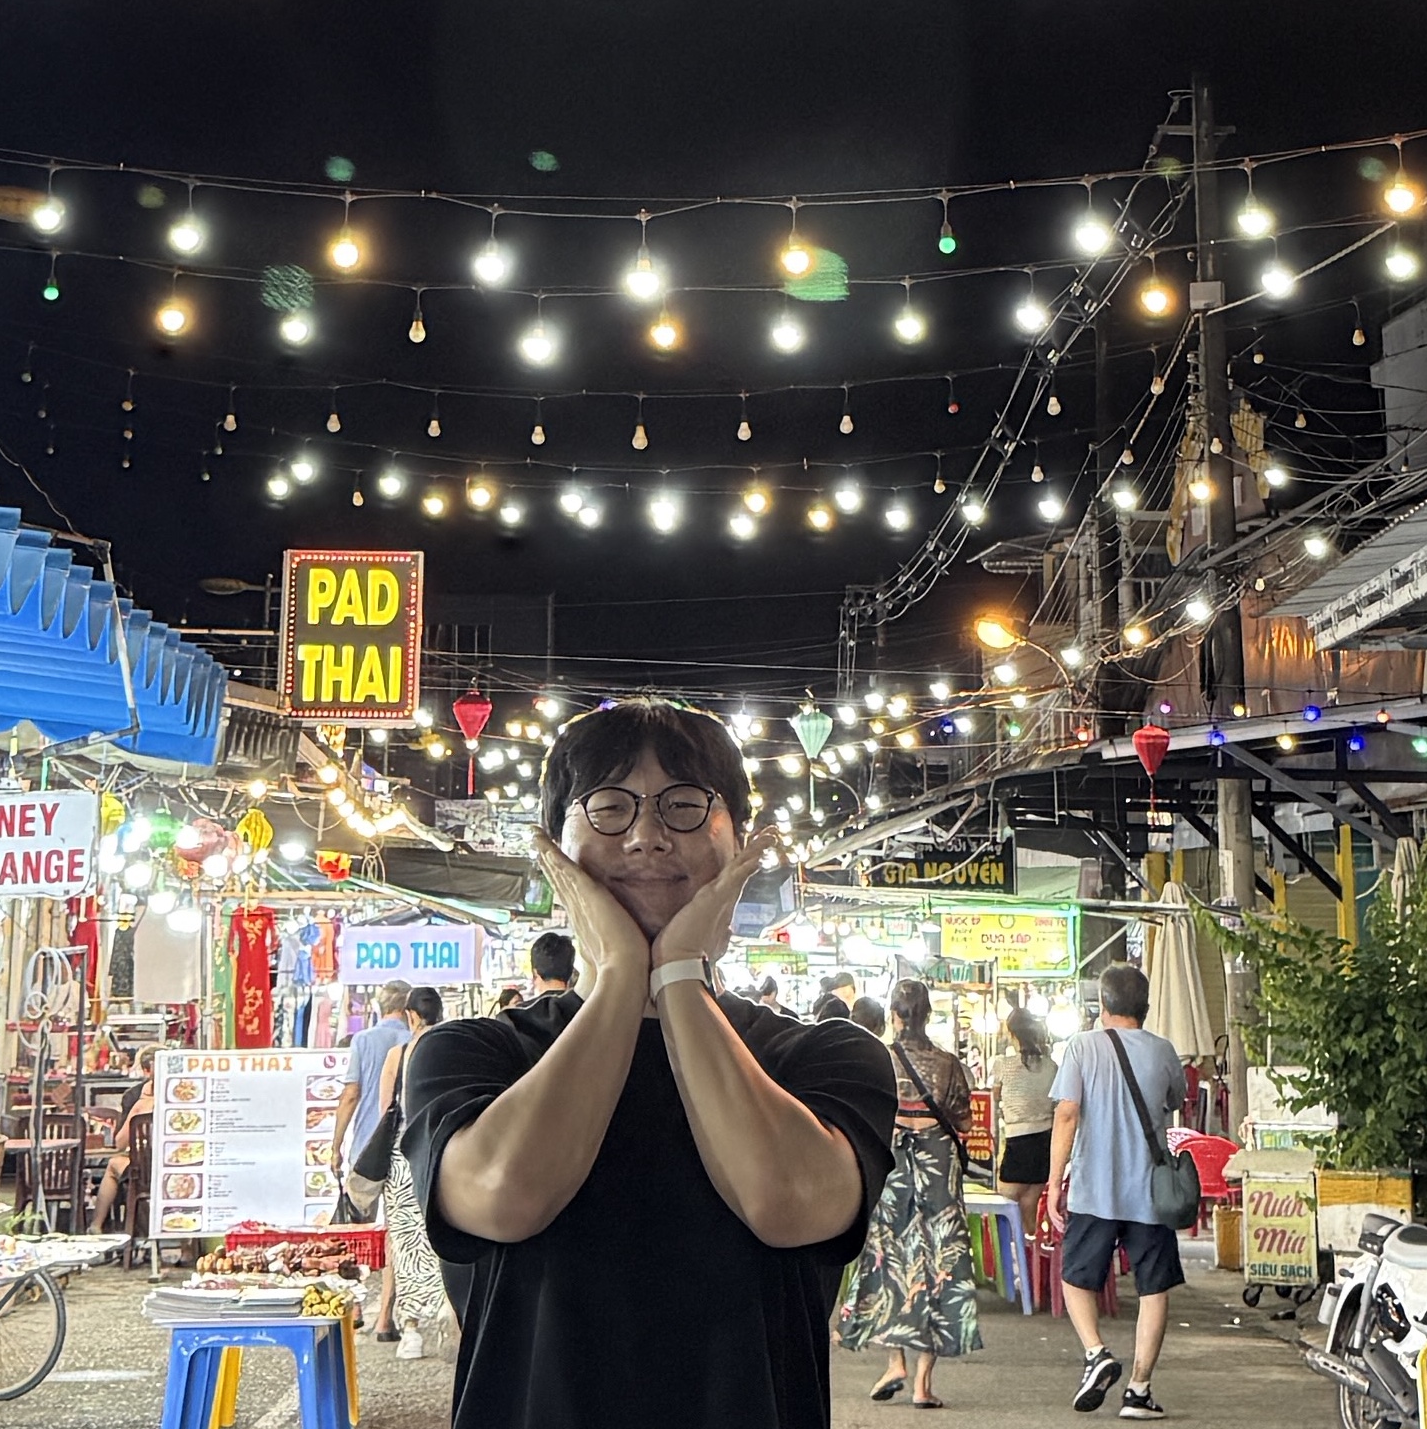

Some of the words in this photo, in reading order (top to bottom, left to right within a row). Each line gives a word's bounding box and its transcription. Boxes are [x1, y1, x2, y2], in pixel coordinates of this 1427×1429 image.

[308, 568, 400, 625] PAD
[297, 645, 402, 703] THAI
[356, 941, 403, 970] PAD
[410, 941, 460, 970] THAI
[187, 1057, 231, 1072] PAD
[237, 1056, 293, 1072] THAI
[1253, 1227, 1306, 1257] Mía
